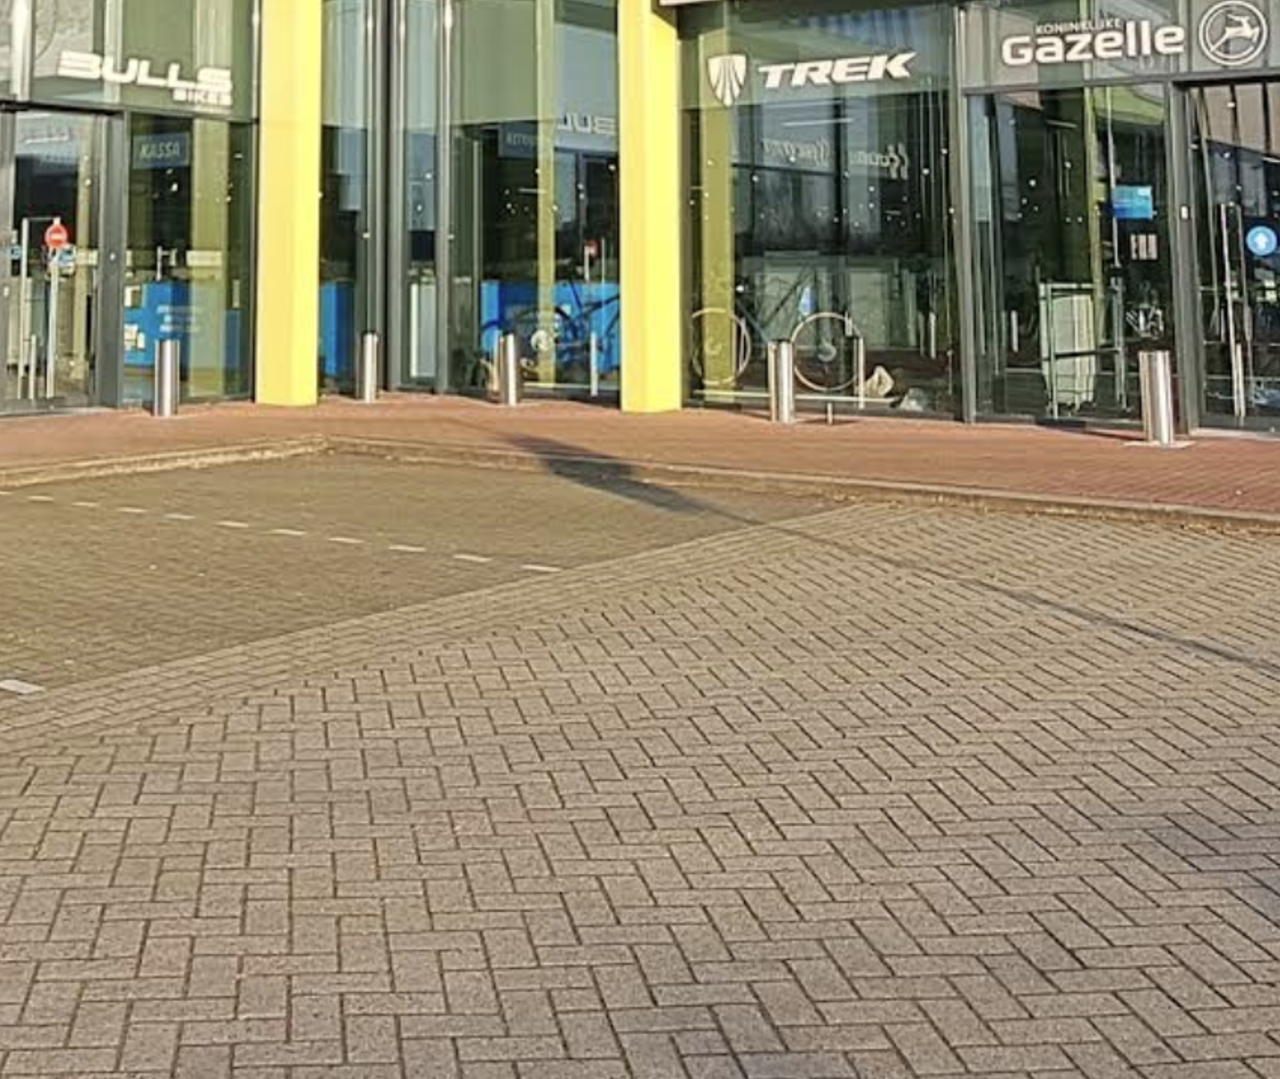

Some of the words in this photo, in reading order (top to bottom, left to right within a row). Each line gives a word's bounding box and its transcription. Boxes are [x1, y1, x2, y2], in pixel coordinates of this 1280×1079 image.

[1001, 19, 1186, 67] Gazelle
[56, 50, 233, 94] BULLS
[757, 51, 918, 90] TREK
